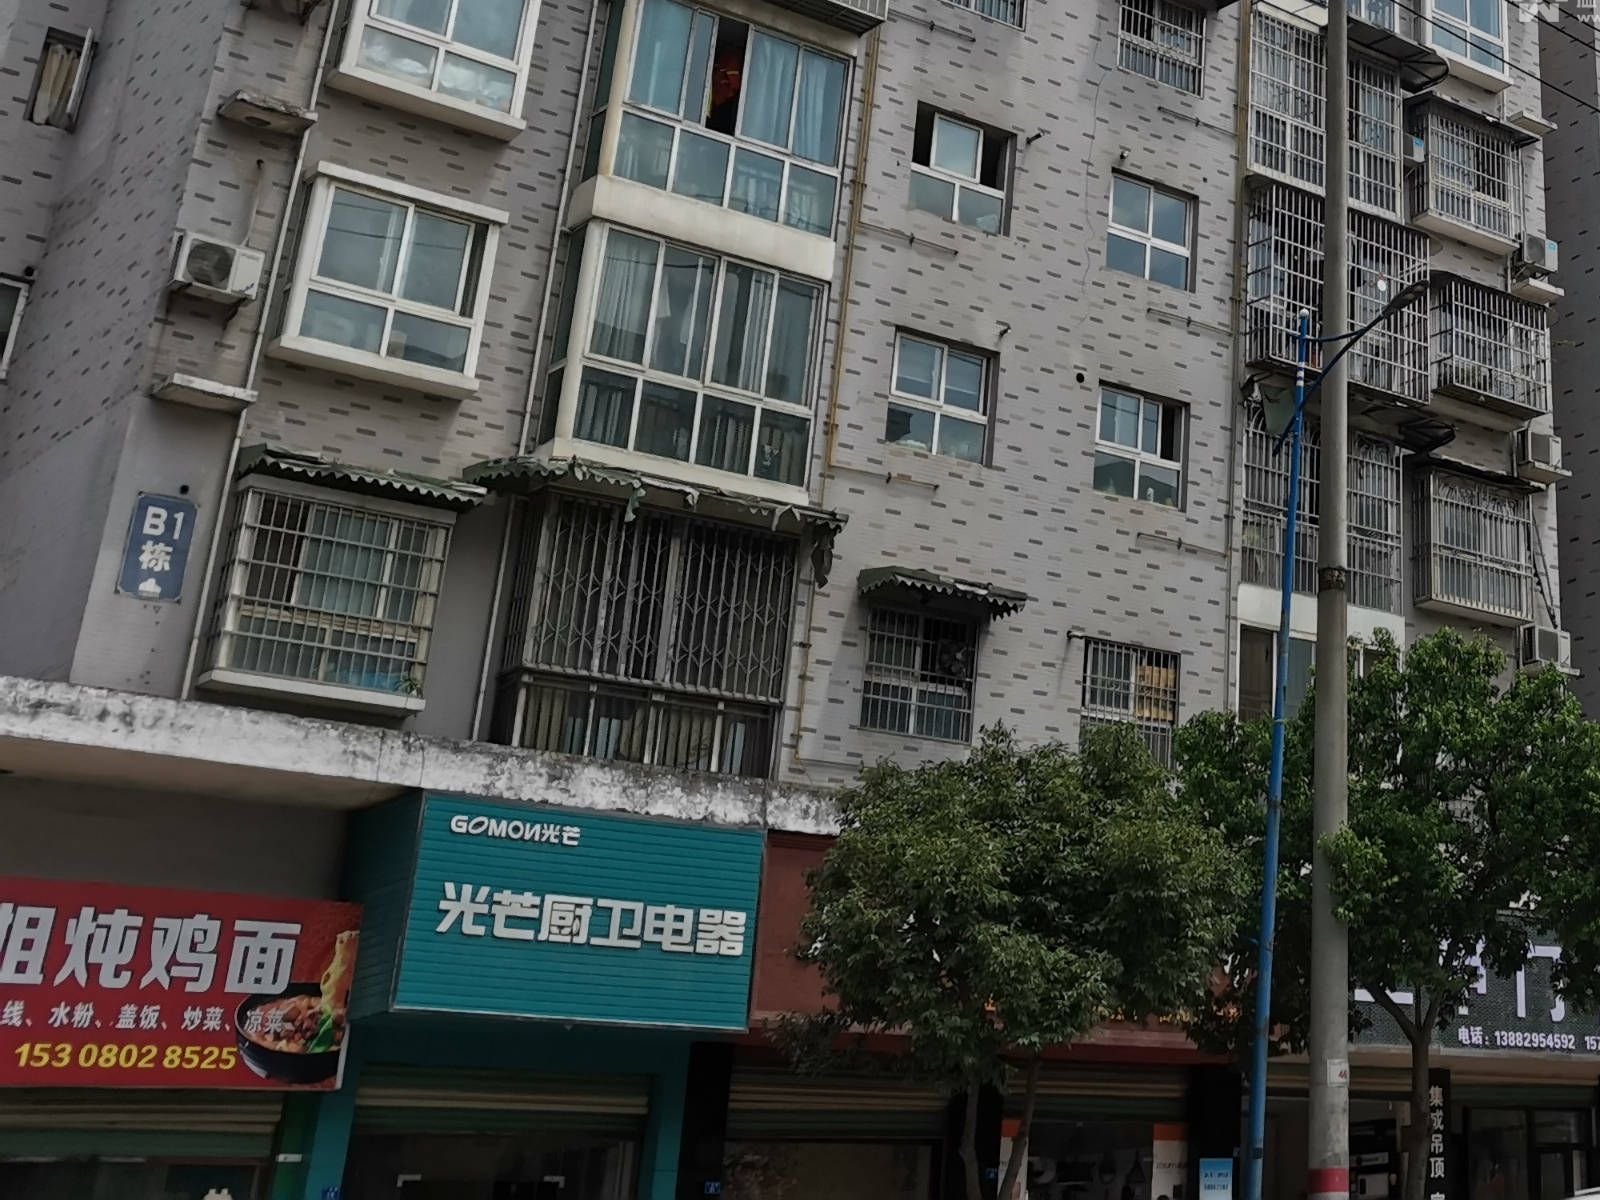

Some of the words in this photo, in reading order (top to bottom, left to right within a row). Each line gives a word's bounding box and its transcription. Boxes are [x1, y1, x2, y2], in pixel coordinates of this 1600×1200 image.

[143, 506, 185, 540] B1
[138, 540, 174, 572] 栋
[435, 881, 747, 957] 光芒厨卫电器
[14, 1042, 72, 1068] 153
[78, 1043, 158, 1069] 0802
[162, 1045, 238, 1070] 8525
